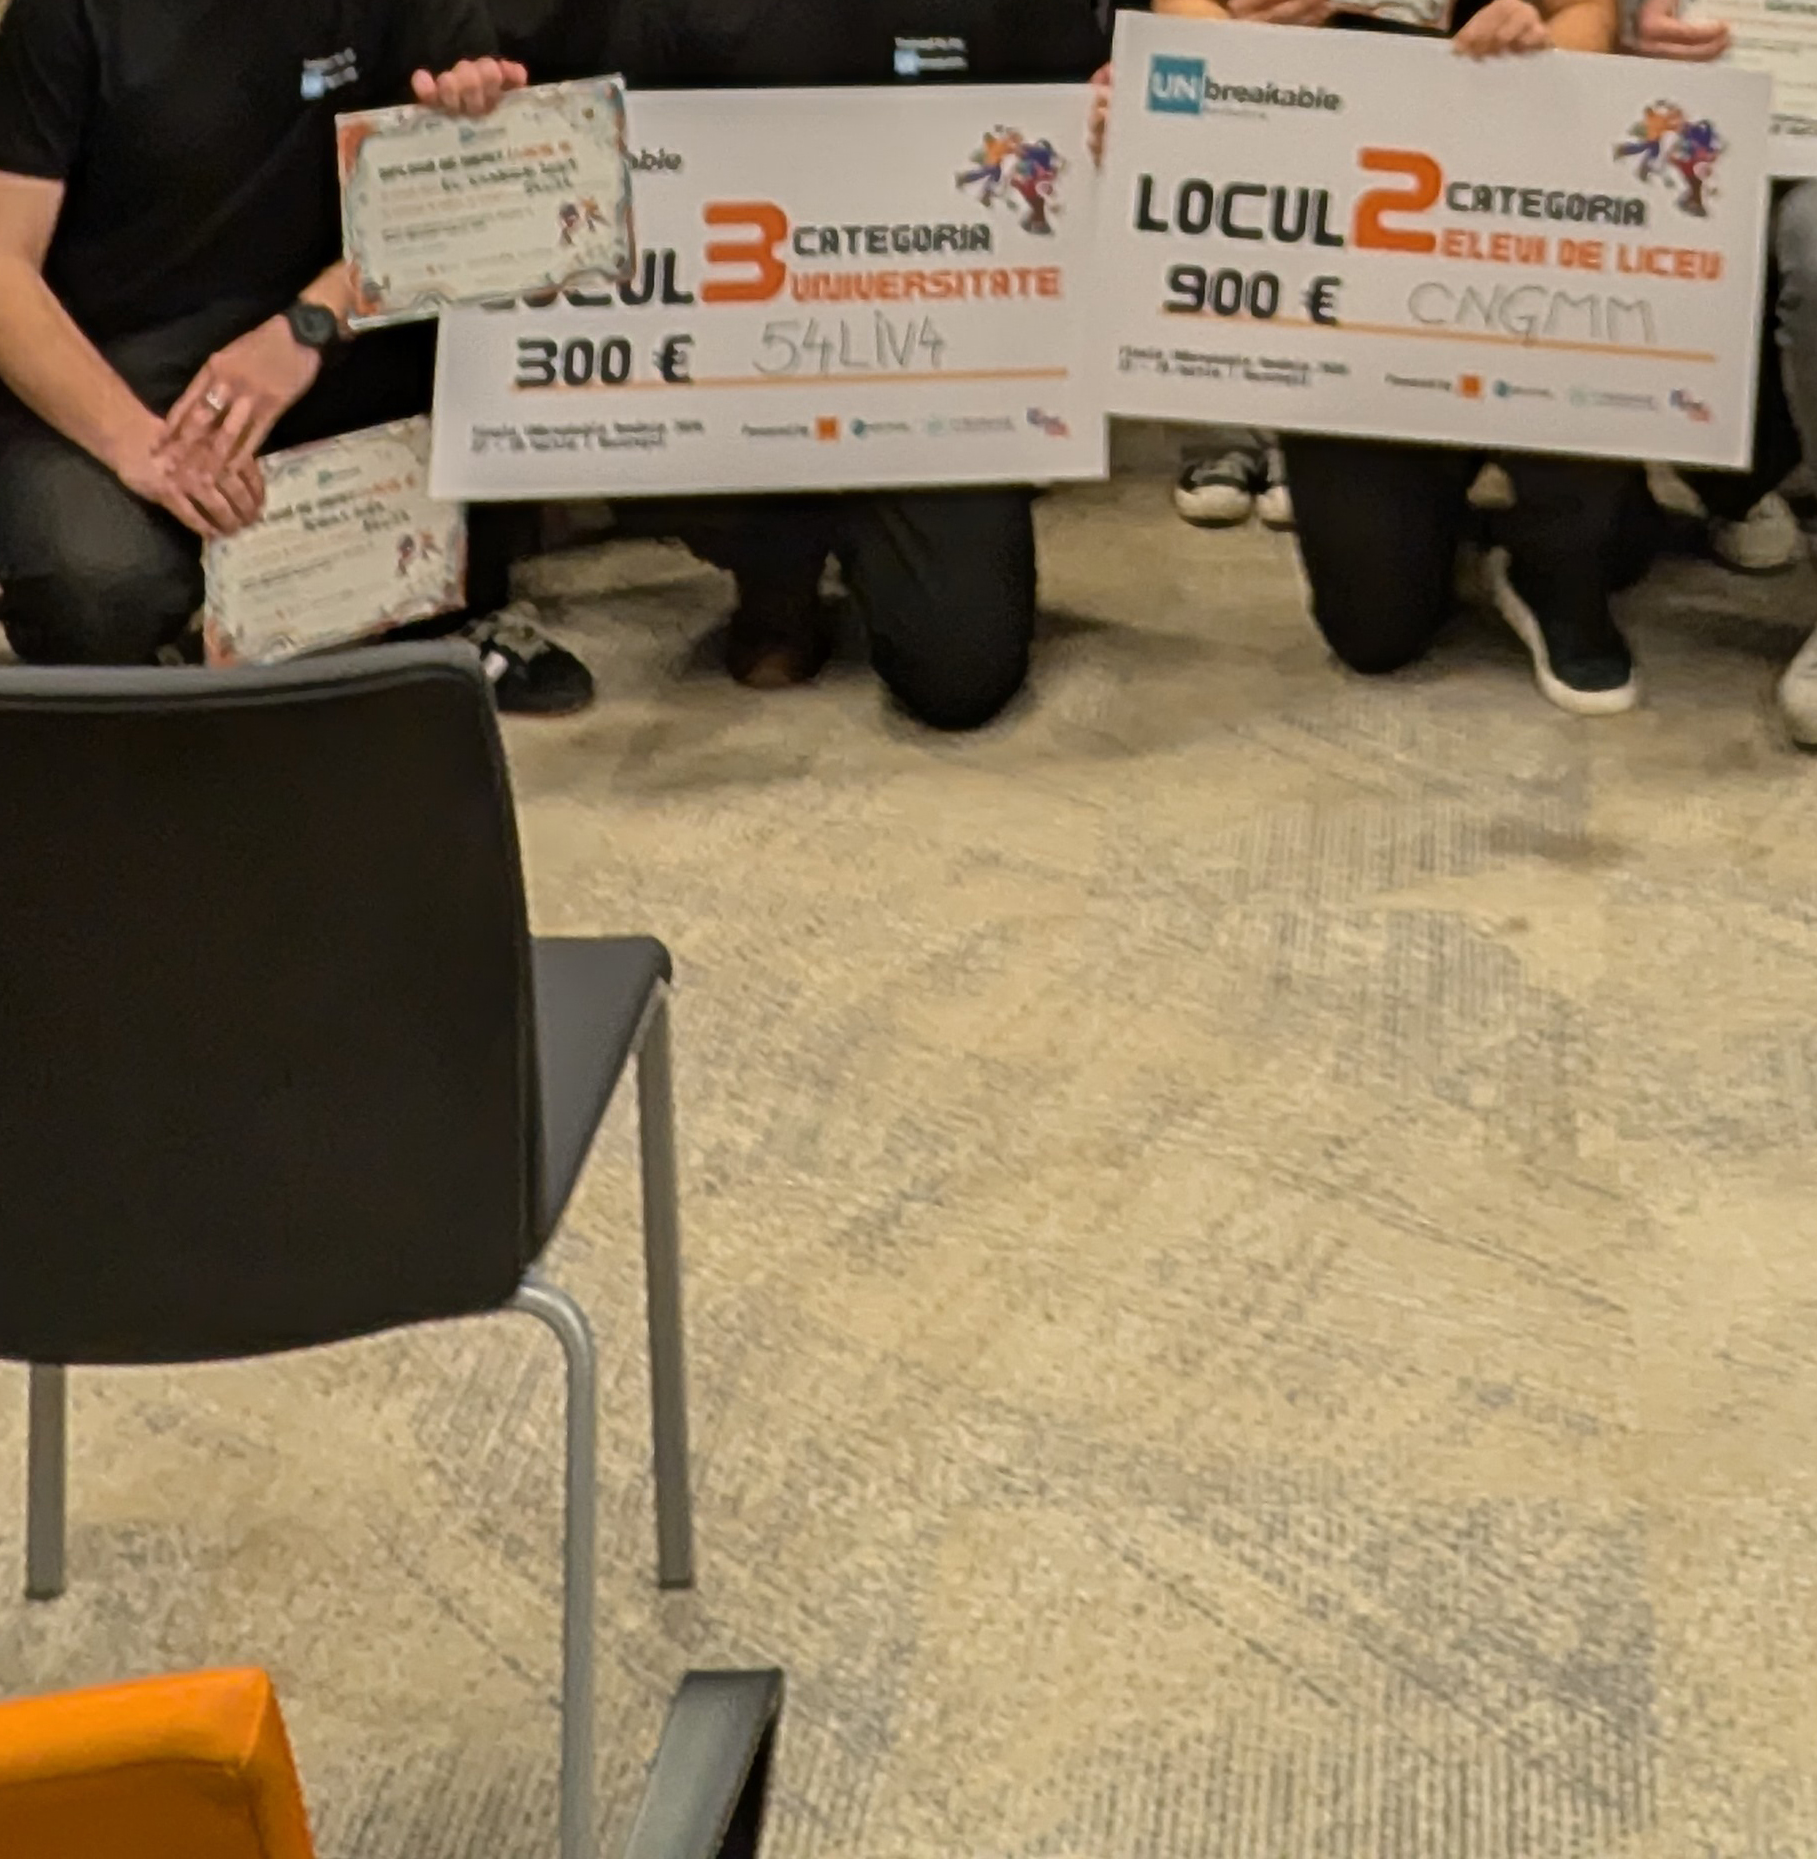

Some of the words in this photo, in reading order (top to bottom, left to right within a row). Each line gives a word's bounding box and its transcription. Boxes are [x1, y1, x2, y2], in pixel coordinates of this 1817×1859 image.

[1134, 172, 1346, 248] LOCUL
[1350, 145, 1444, 255] 2
[1444, 182, 1646, 226] CATEGORIA
[700, 200, 790, 305] 3
[792, 223, 992, 257] CATEGORIA
[1557, 239, 1604, 270] DE
[789, 267, 1063, 303] UNIVERSITATE
[1161, 263, 1280, 318] 900
[1302, 275, 1342, 326] €
[514, 336, 633, 388] 300
[653, 334, 695, 386] €
